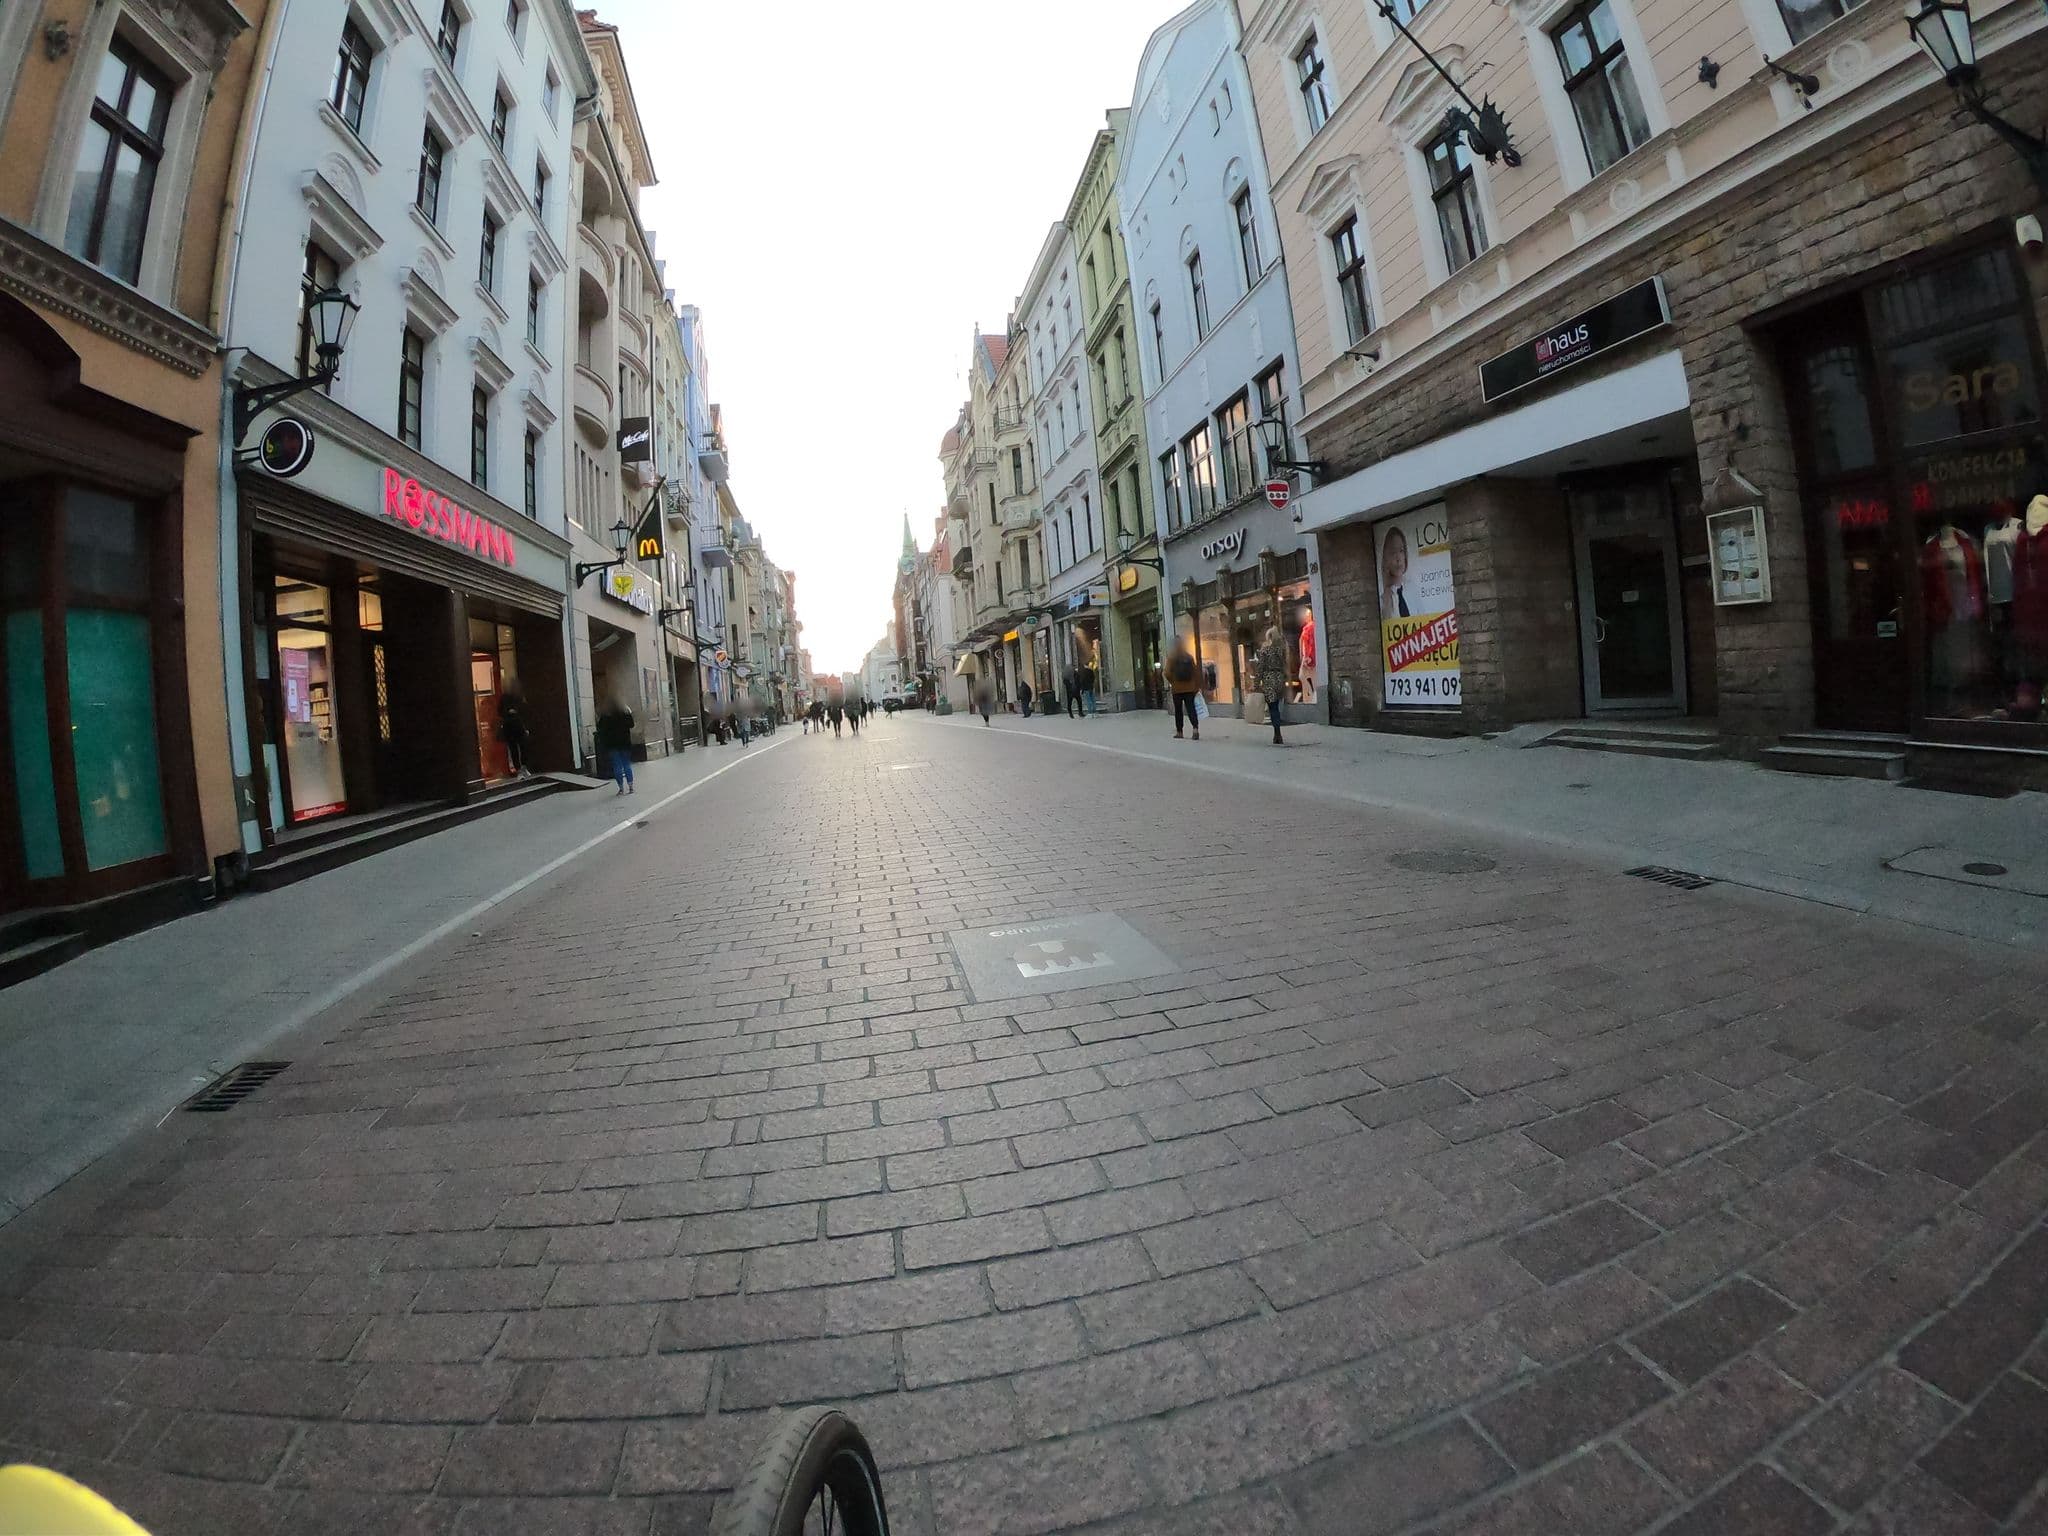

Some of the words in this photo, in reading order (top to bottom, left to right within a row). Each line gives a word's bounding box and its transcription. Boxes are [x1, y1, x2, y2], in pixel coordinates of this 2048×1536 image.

[1547, 324, 1589, 356] haus
[1538, 344, 1592, 374] nieruchomości
[1903, 362, 2018, 413] Sara
[384, 466, 514, 567] ROSSMANN
[1201, 528, 1246, 560] orsay
[1420, 568, 1450, 583] Joanna
[1390, 613, 1458, 666] WYNAJĘTE
[1391, 678, 1411, 696] 793
[1415, 678, 1436, 696] 941
